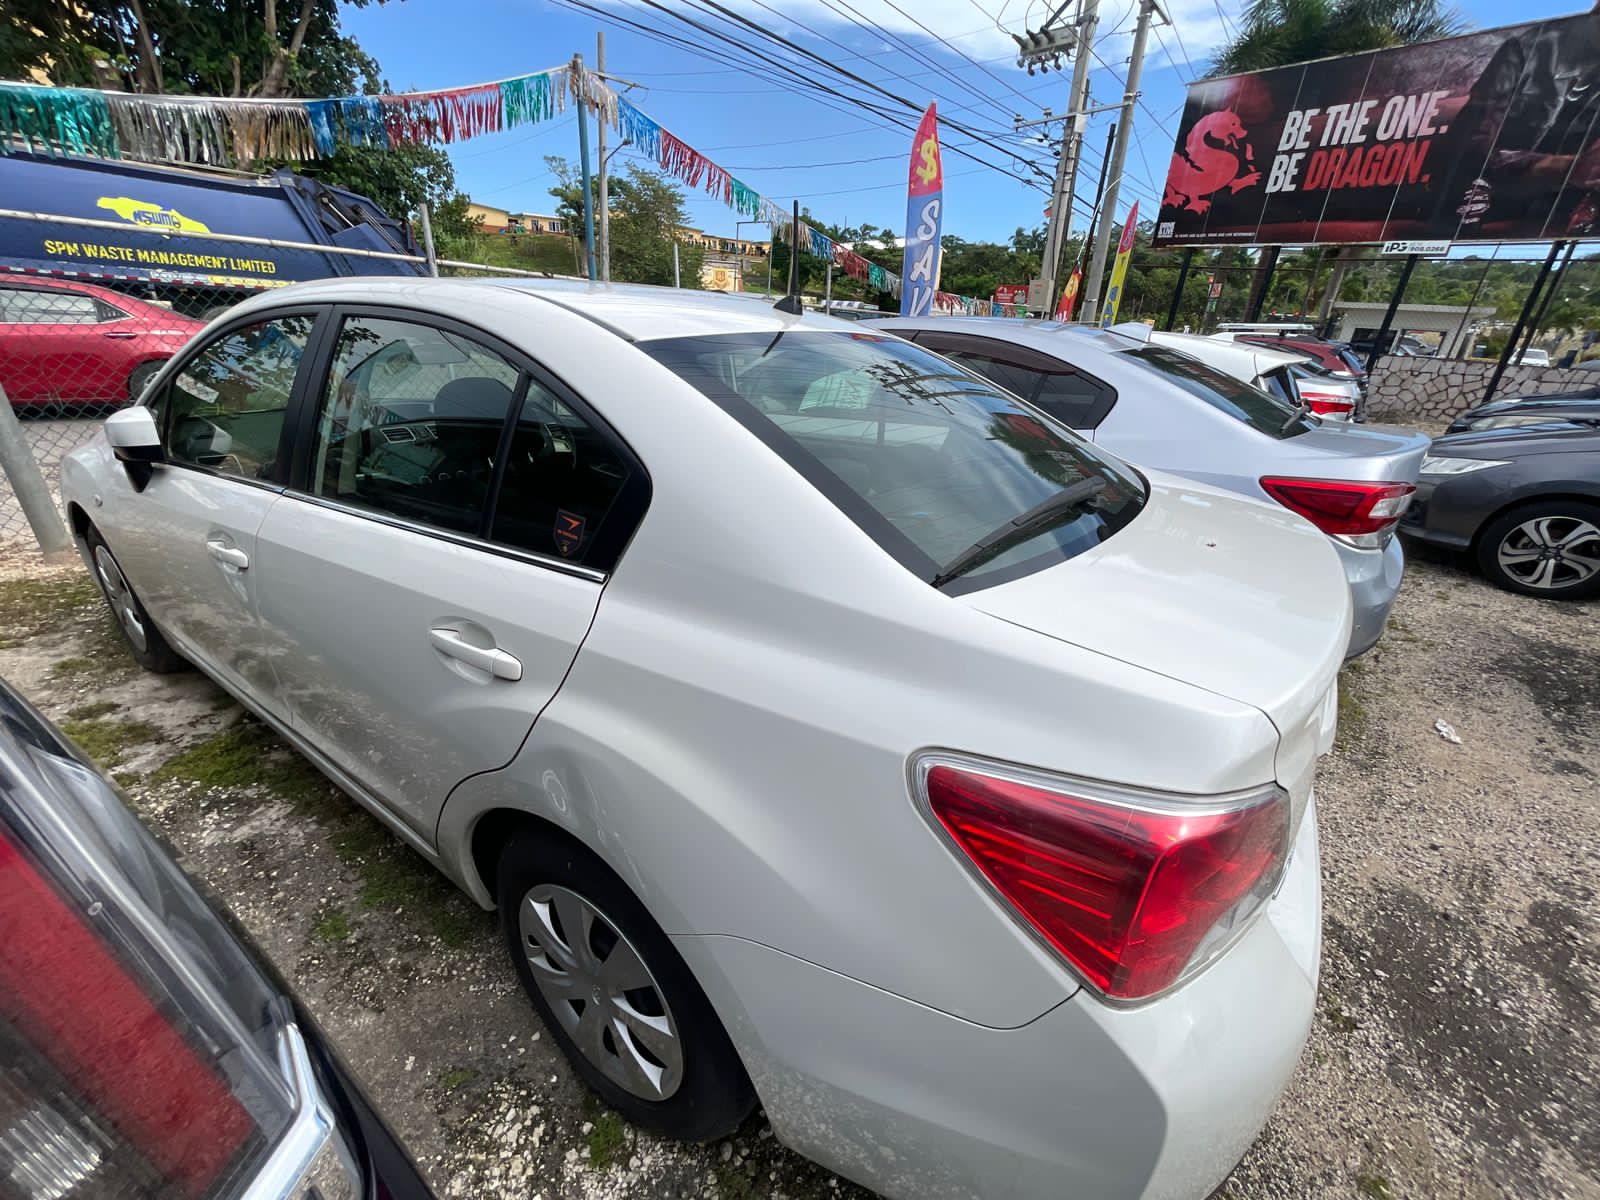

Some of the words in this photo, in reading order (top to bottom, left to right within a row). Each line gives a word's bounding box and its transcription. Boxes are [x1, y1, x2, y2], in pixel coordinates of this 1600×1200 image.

[1277, 108, 1320, 151] BE
[1319, 99, 1379, 147] THE
[1375, 90, 1450, 142] ONE.
[1265, 152, 1306, 194] BE
[1302, 140, 1432, 191] DRAGON.
[44, 239, 81, 257] SPM
[81, 243, 136, 262] WASTE
[136, 249, 228, 270] MANAGEMENT
[230, 258, 277, 274] LIMITED
